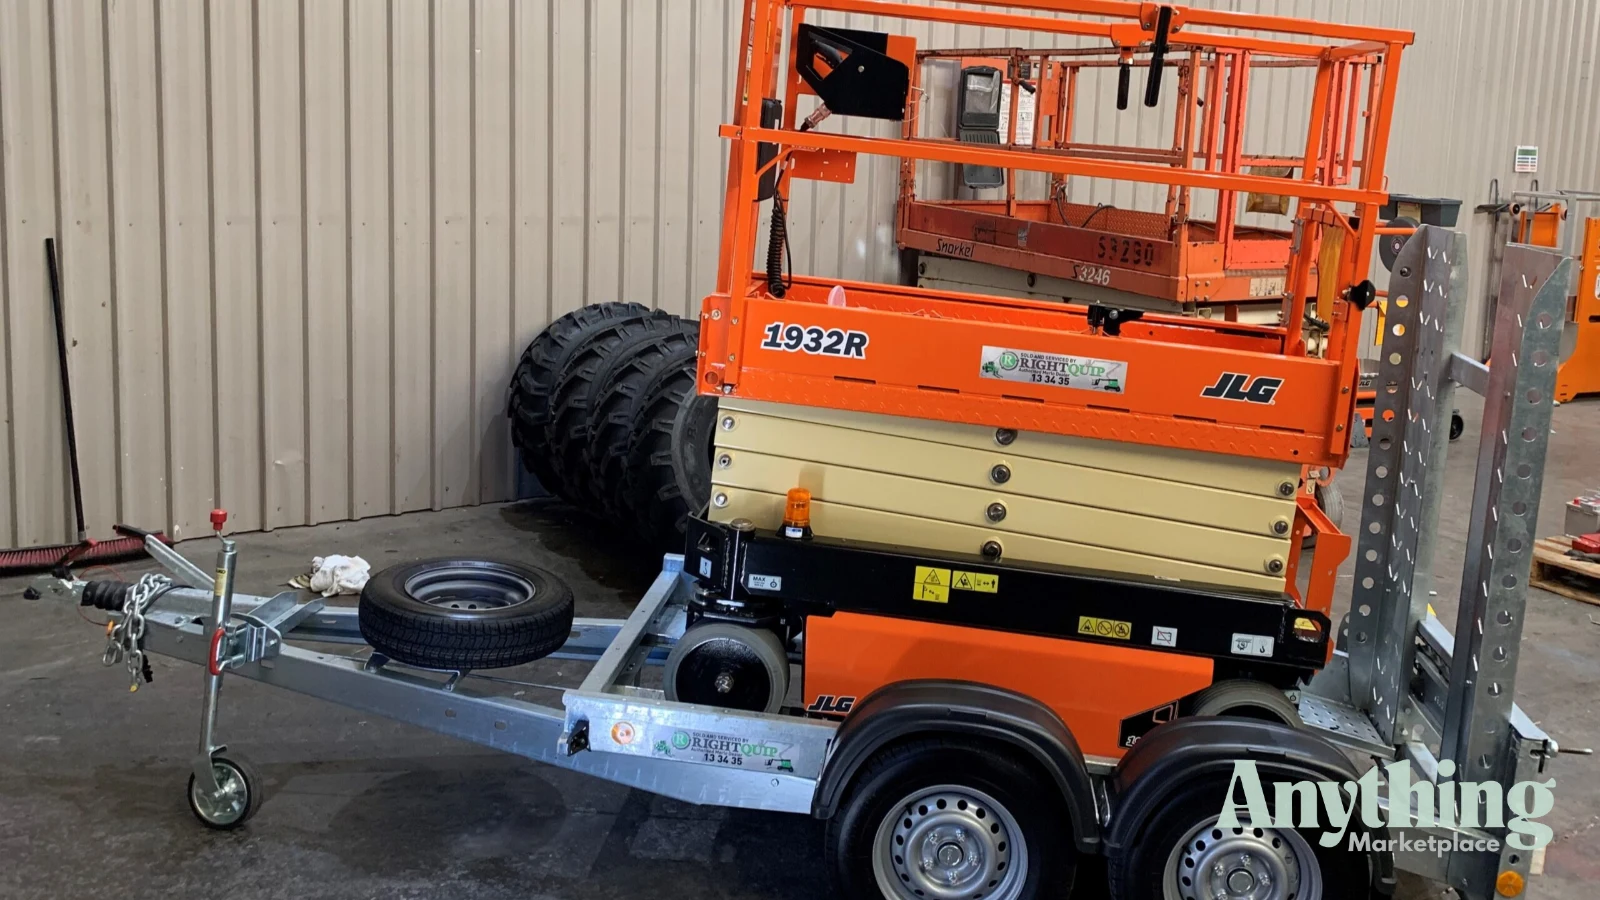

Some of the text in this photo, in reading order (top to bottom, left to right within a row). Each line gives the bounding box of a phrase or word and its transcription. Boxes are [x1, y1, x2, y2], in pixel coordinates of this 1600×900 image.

[935, 238, 975, 258] Snorkel
[1071, 264, 1111, 286] S3246
[761, 321, 868, 360] 1932R
[1019, 357, 1106, 378] RIGHTQUIP
[1045, 355, 1070, 363] SERVICED
[1031, 373, 1070, 386] 13 34 35
[1199, 371, 1285, 405] JLG
[806, 694, 857, 714] JLG
[692, 736, 778, 757] RIGHTQUIP
[704, 753, 743, 766] 13 34 35
